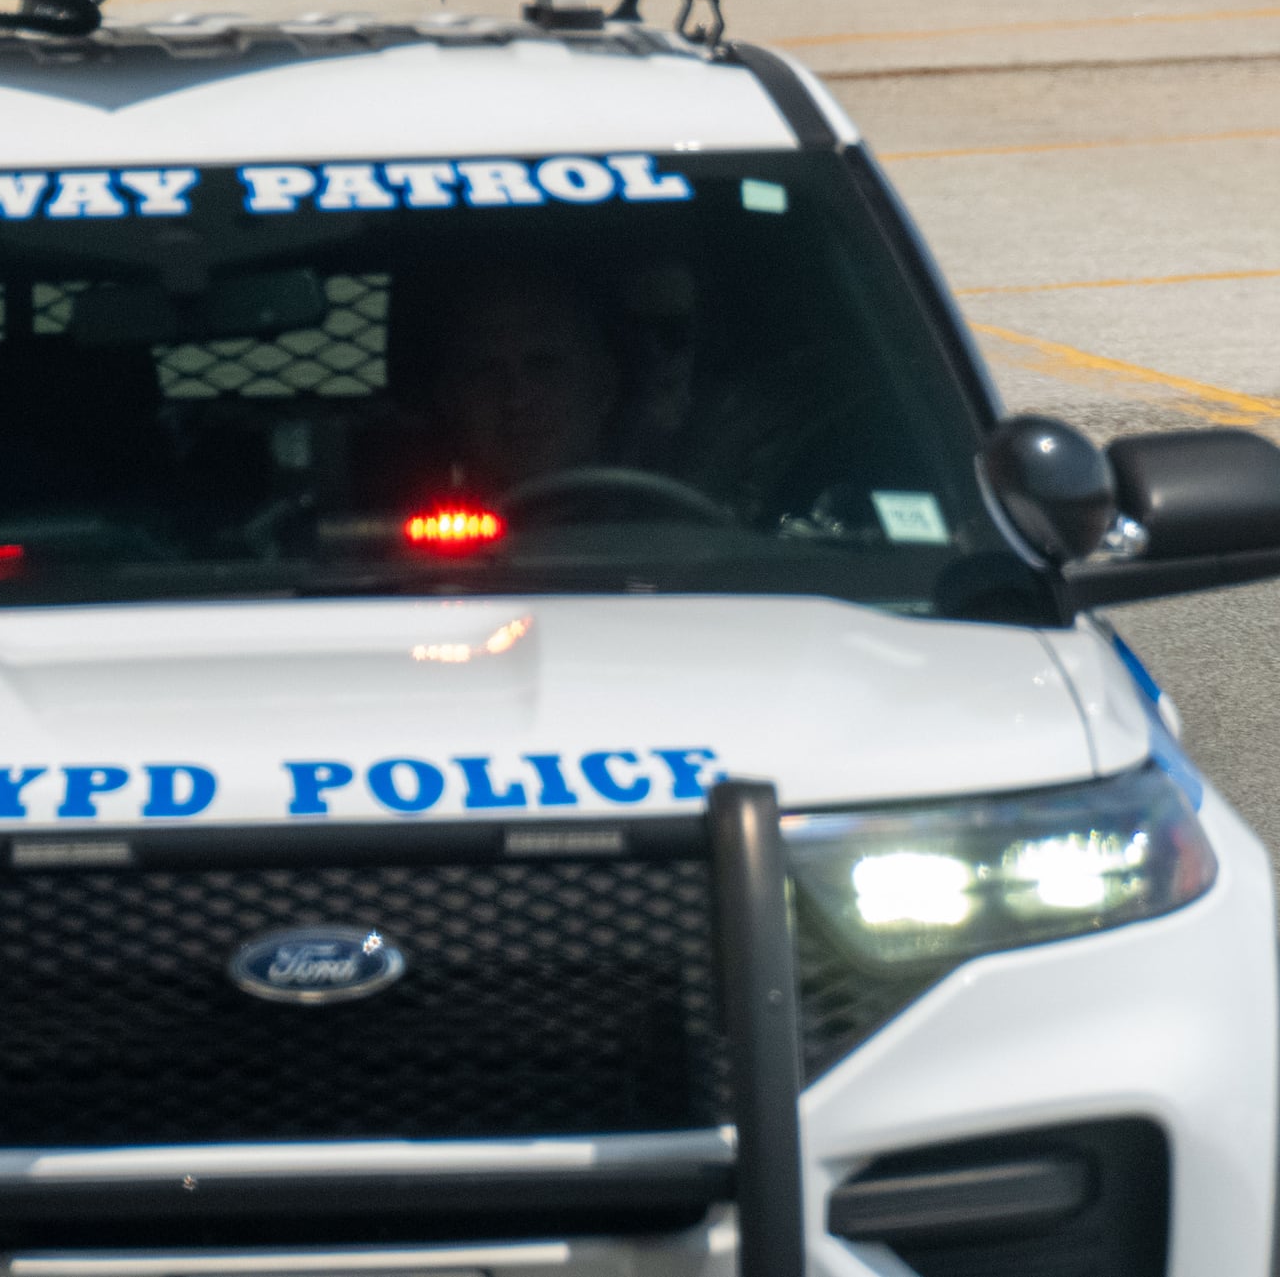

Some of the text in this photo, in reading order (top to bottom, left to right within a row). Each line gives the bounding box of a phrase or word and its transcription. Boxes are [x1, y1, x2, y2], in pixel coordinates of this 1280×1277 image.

[239, 154, 693, 213] PATROL
[282, 748, 729, 815] POLICE
[268, 943, 359, 983] Ford
